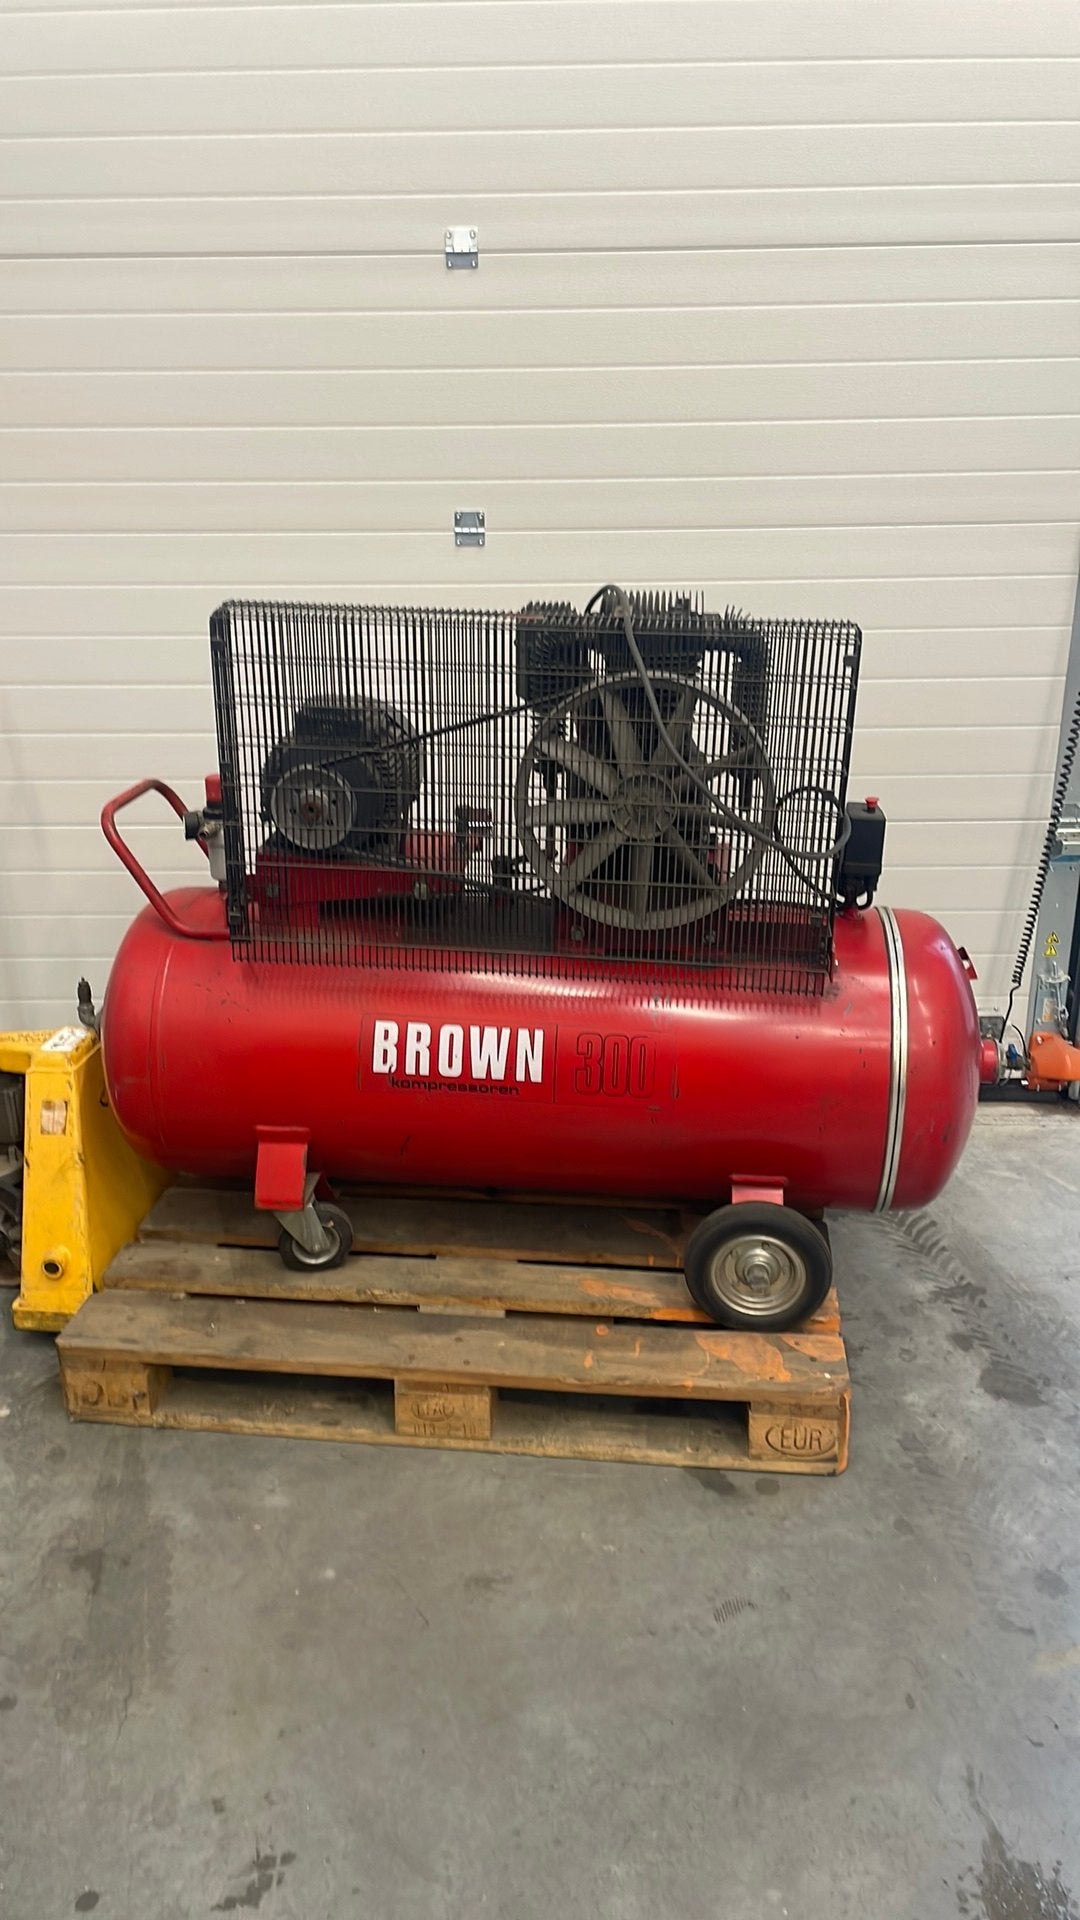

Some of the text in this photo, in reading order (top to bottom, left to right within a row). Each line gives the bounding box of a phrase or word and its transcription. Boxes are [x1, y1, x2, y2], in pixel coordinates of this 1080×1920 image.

[372, 1019, 656, 1099] BROWN 300
[391, 1076, 520, 1096] kompressoren
[781, 1427, 822, 1451] EUR
